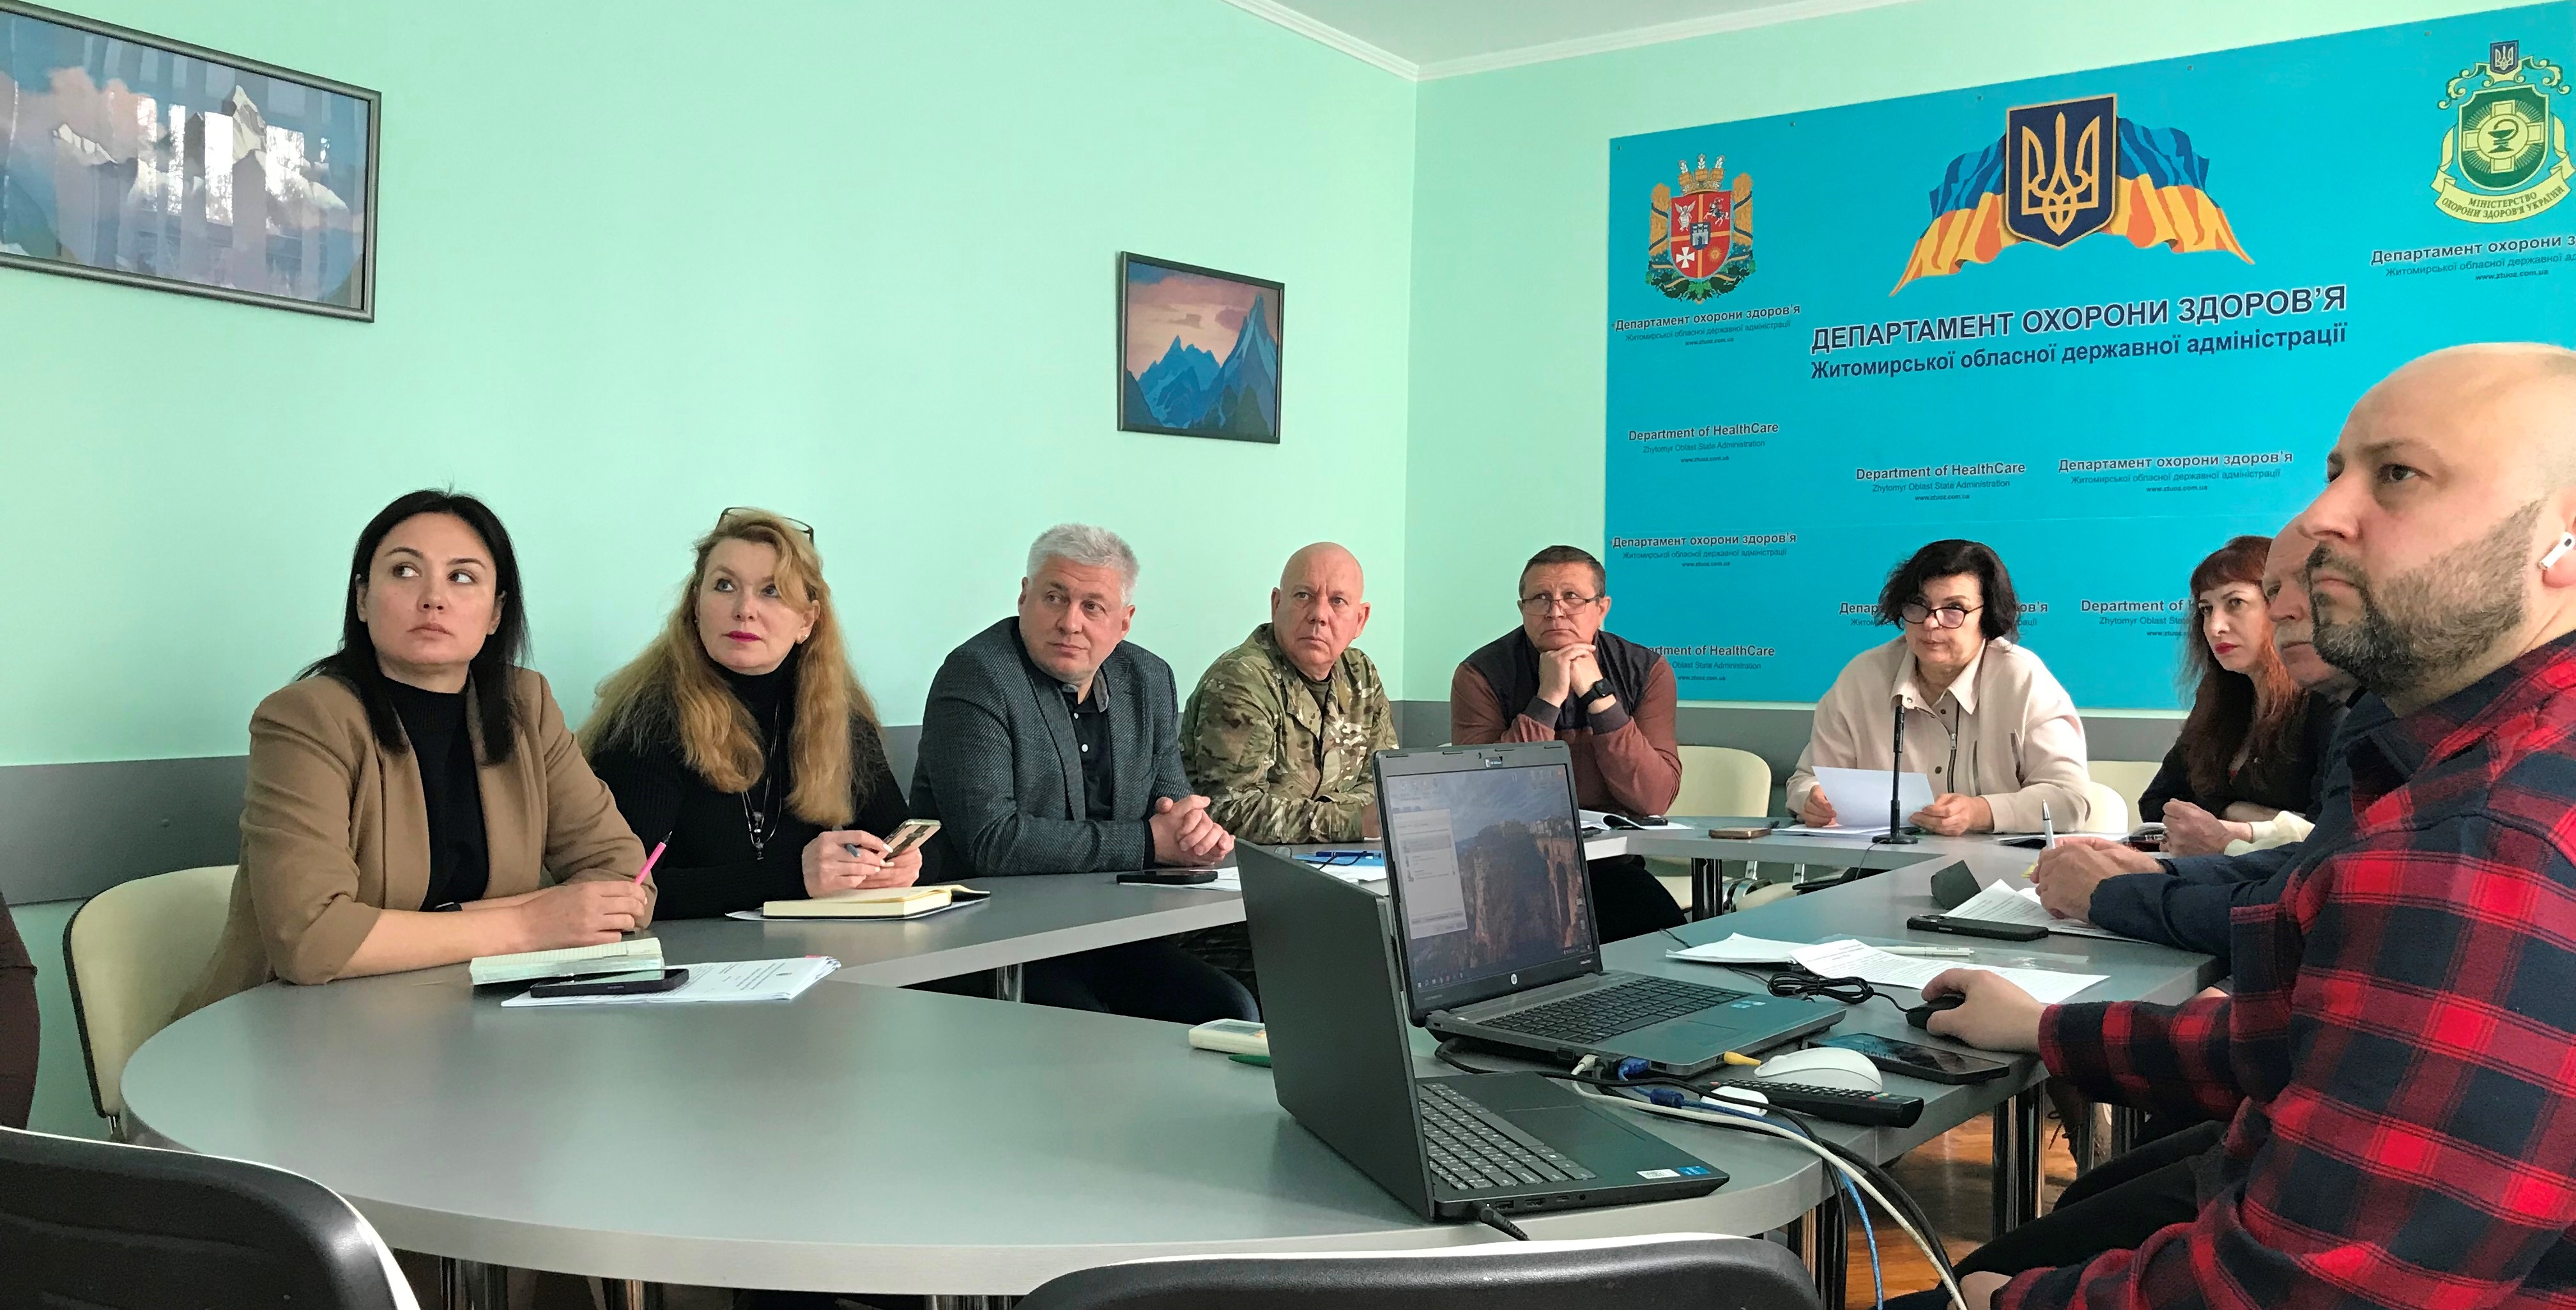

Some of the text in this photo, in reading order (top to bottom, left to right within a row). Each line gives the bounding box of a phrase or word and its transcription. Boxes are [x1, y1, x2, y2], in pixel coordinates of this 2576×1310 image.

[2441, 197, 2480, 218] ОХОРОНИ
[2527, 185, 2565, 212] УКРАЇНИ
[2468, 192, 2537, 208] МІНІСТЕРСТВО
[2371, 243, 2483, 265] Департамент
[2488, 236, 2561, 252] охорони
[2386, 263, 2457, 277] Житомирської
[2460, 259, 2505, 270] обласної
[2508, 253, 2563, 267] державної
[2475, 269, 2549, 281] www.ztuoz.com.ua
[1616, 304, 1800, 332] Департамент охорони здоров'я
[1811, 285, 2346, 355] ДЕПАРТАМЕНТ ОХОРОНИ ЗДОРОВ’Я
[1811, 321, 2348, 379] Житомирської обласної державної адміністрації
[1629, 422, 1779, 442] Department of HealthCare
[1857, 462, 2025, 481] Department of HealthCare
[2058, 451, 2293, 473] Департамент охорони здоров'я
[1873, 484, 1906, 493] Zhytomyr
[1935, 481, 1954, 490] State
[1956, 479, 2010, 489] Administration
[1613, 532, 1797, 549] Департамент охорони здоров'я
[2081, 599, 2165, 614] Department
[2169, 599, 2184, 612] of
[1695, 645, 1706, 656] of
[1710, 645, 1775, 657] HealthCare
